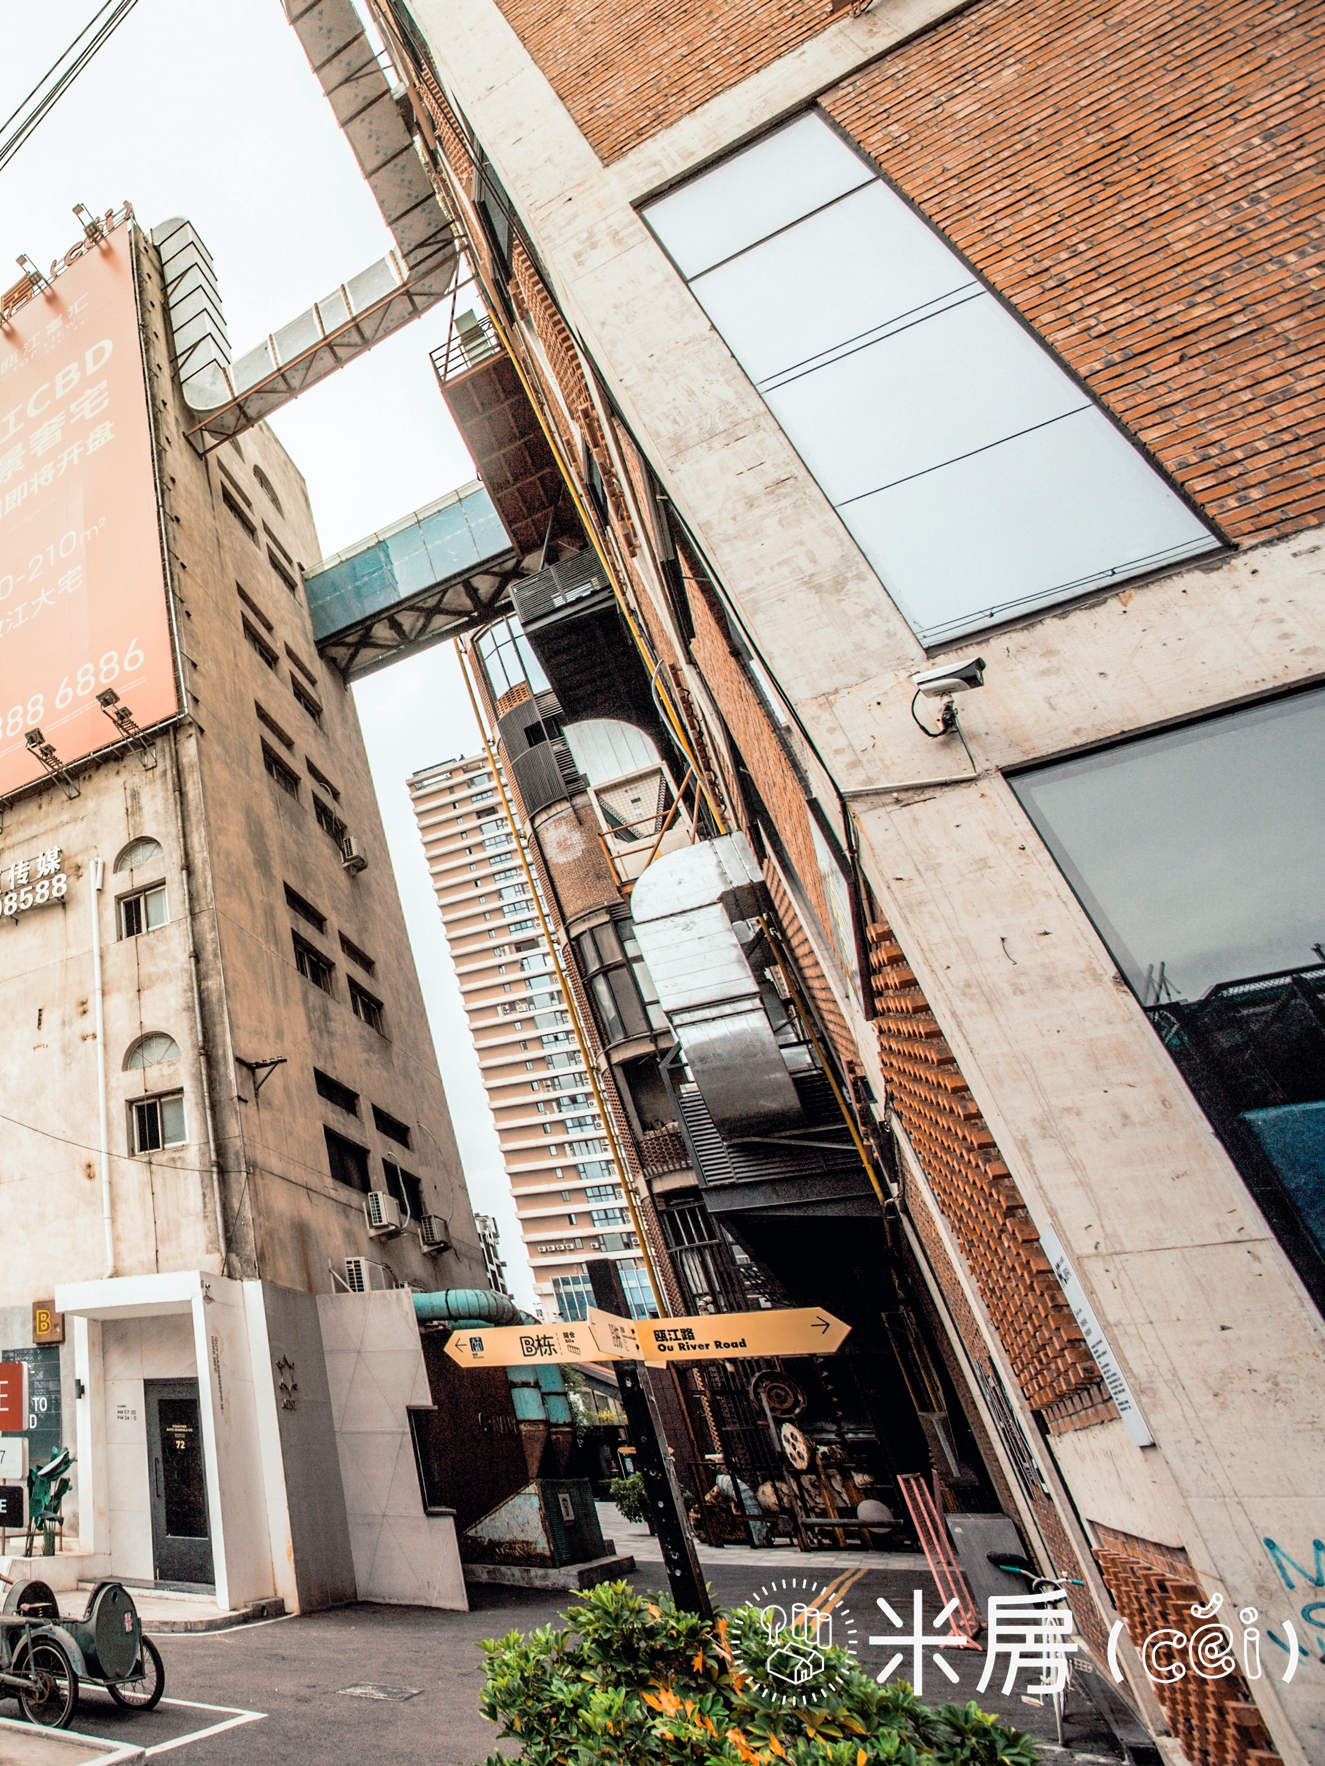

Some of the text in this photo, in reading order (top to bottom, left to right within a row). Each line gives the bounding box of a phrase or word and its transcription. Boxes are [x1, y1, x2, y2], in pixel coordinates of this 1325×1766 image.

[54, 638, 145, 709] 6886
[653, 1328, 696, 1342] 瓯江路
[519, 1334, 558, 1357] B栋
[657, 1338, 748, 1352] Ou River Road
[175, 1440, 186, 1450] 72
